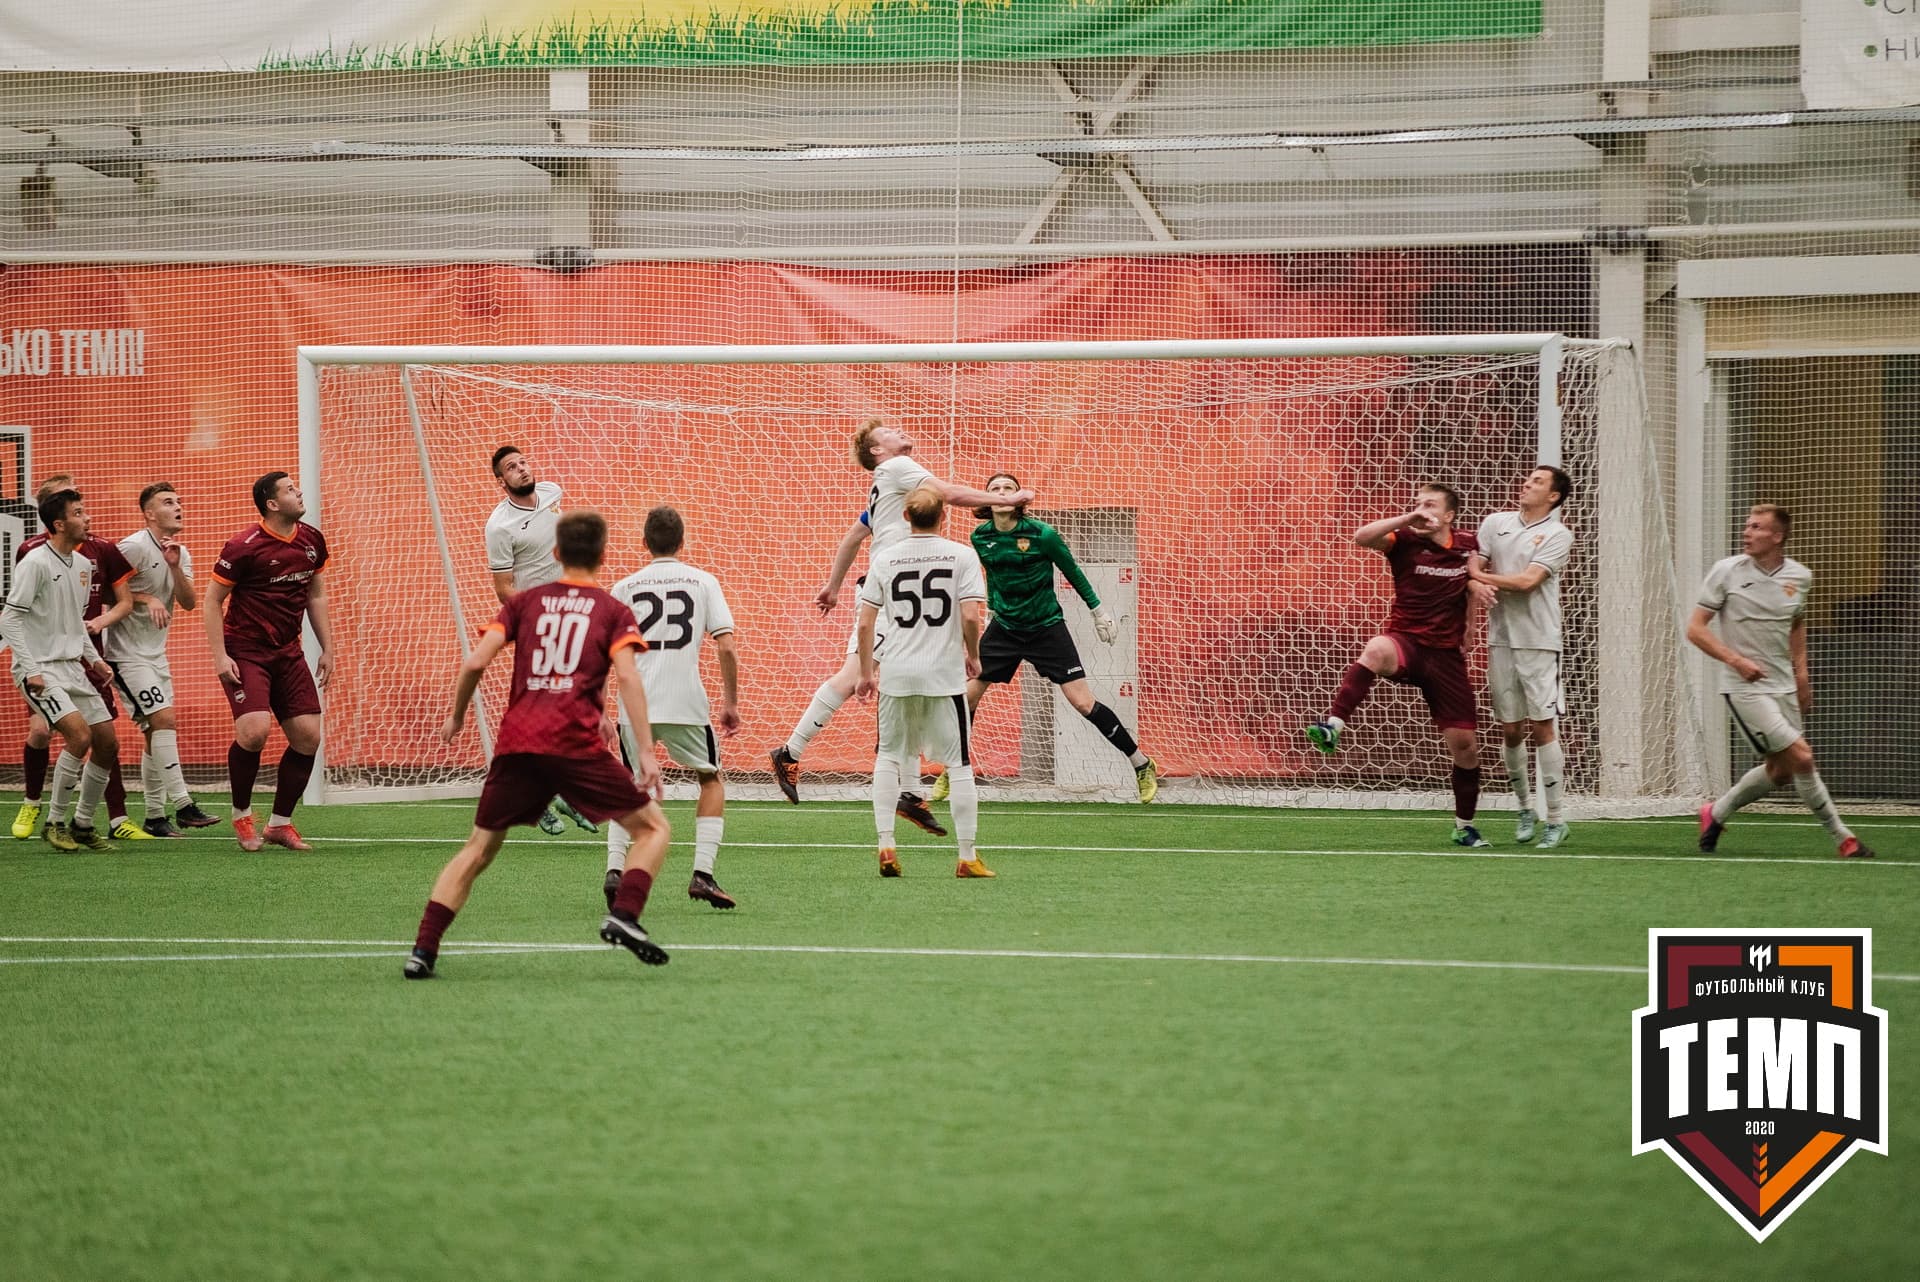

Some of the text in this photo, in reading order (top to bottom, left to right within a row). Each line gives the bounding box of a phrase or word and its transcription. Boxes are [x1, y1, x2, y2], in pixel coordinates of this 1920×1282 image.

[60, 329, 144, 377] ТЕМП!
[541, 595, 596, 615] ЧЕРНОВ
[632, 590, 694, 650] 23
[891, 568, 953, 629] 55
[531, 612, 590, 676] 30
[44, 695, 62, 715] 11
[139, 685, 165, 709] 98
